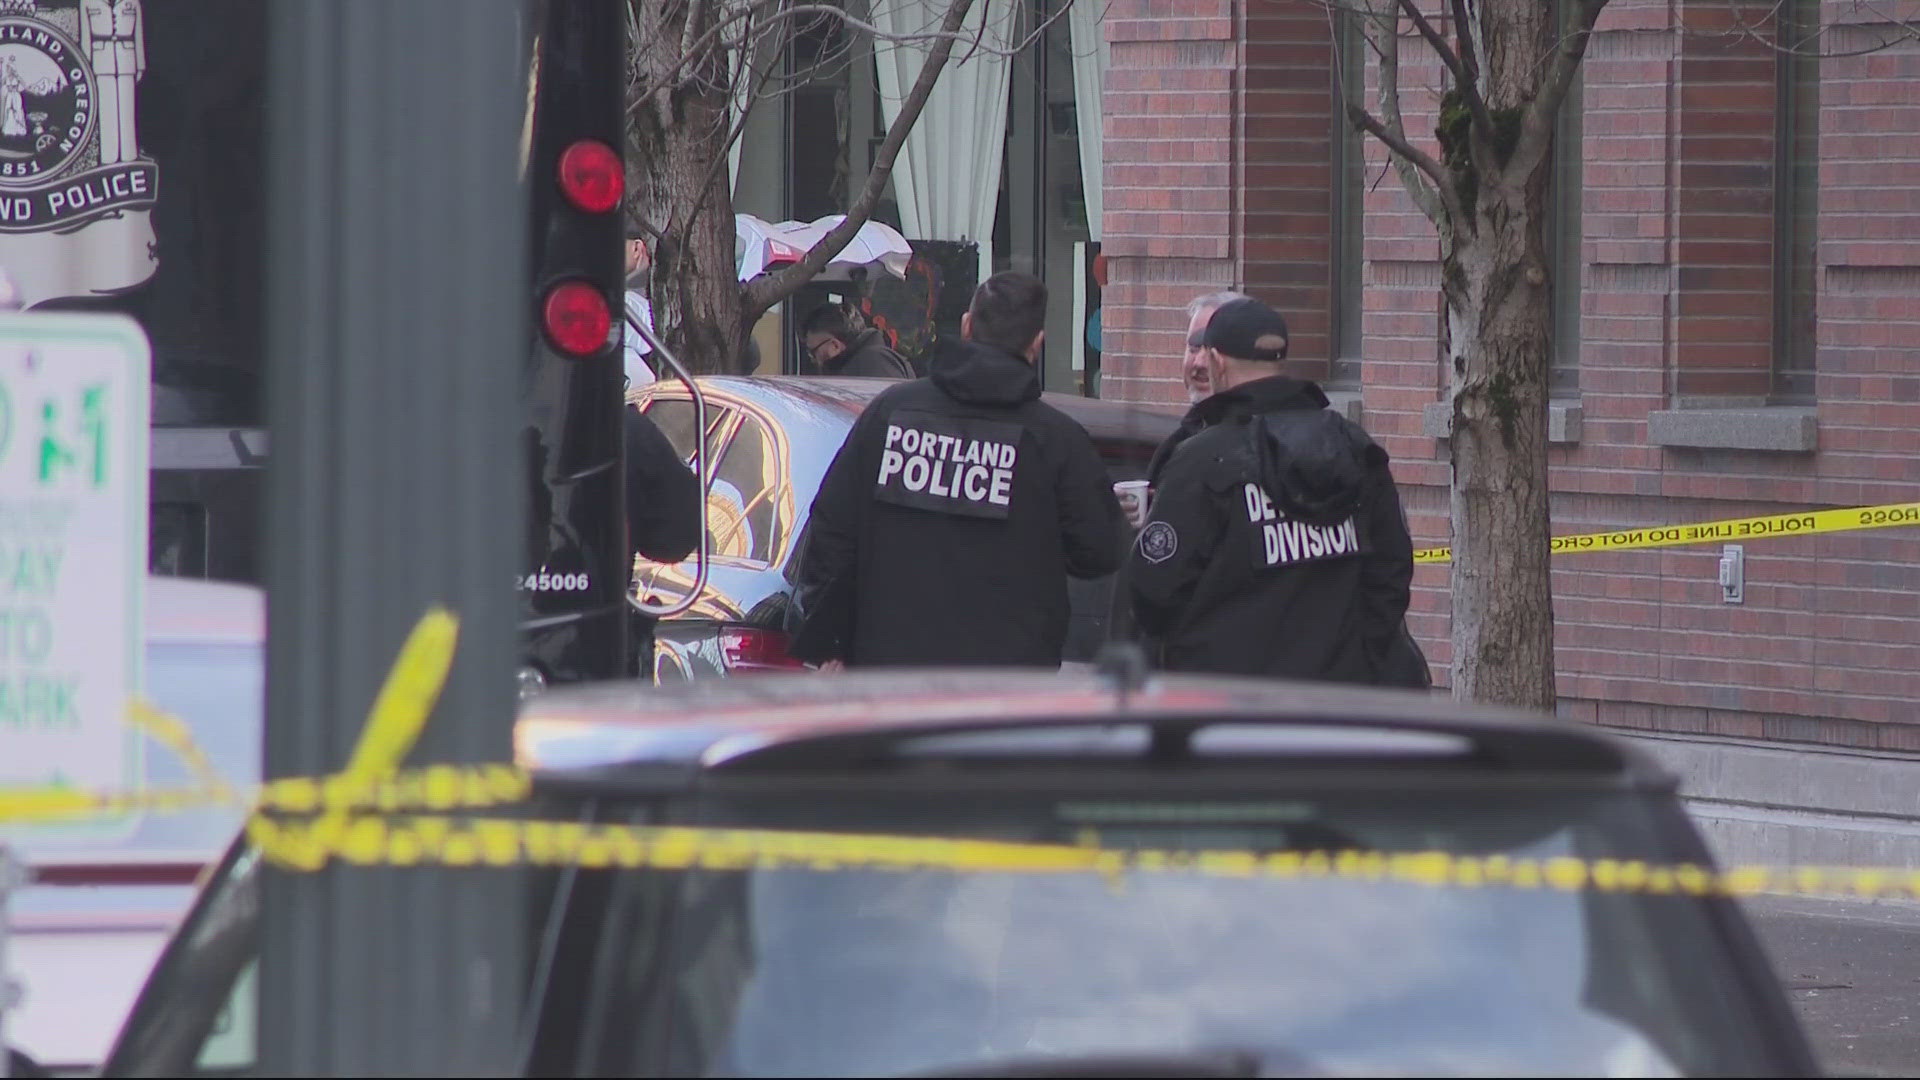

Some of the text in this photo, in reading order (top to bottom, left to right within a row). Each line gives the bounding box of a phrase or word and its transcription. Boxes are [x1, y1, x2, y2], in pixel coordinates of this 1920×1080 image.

[59, 68, 88, 152] OREGON
[48, 170, 147, 215] POLICE
[885, 425, 1016, 468] PORTLAND
[877, 449, 1013, 506] POLICE
[1263, 515, 1359, 564] DIVISION
